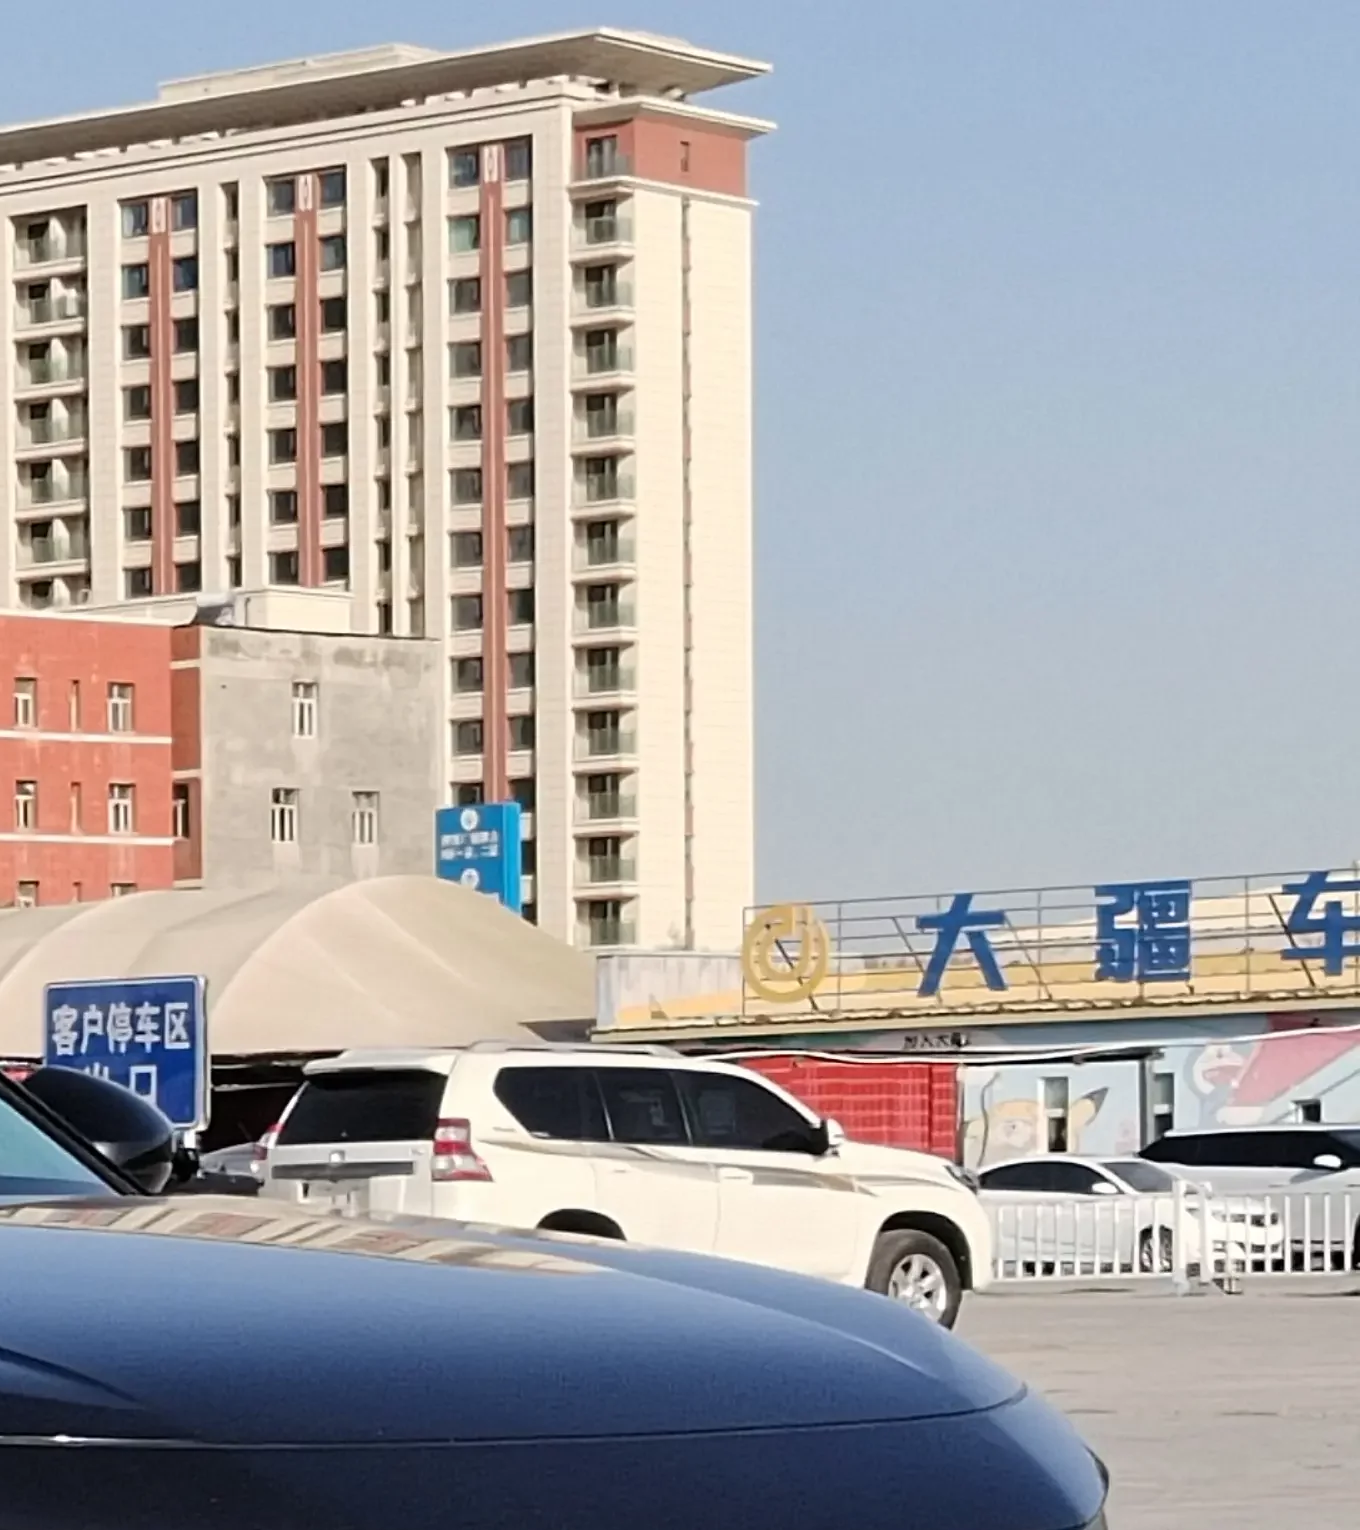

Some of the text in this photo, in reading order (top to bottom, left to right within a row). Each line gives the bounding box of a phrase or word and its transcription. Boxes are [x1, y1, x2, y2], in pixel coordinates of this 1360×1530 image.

[52, 1001, 191, 1056] 客户停车区
